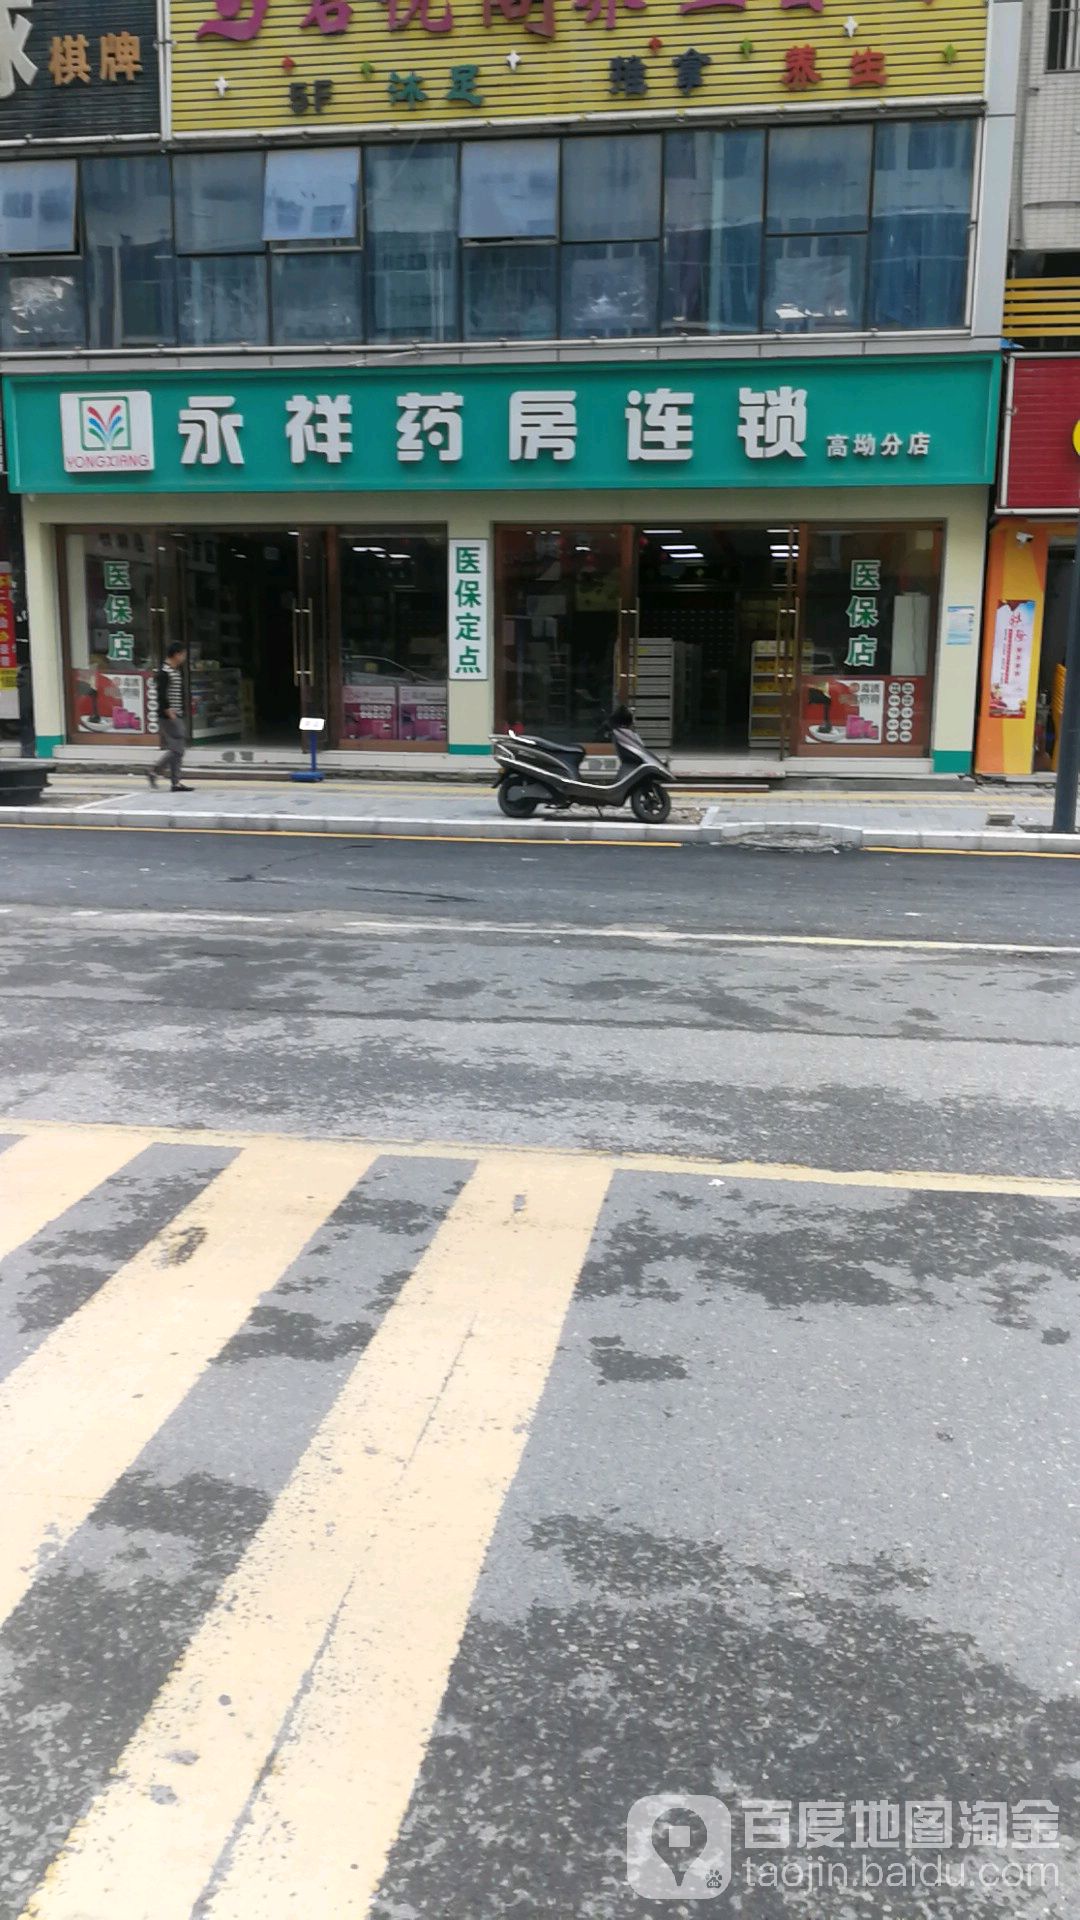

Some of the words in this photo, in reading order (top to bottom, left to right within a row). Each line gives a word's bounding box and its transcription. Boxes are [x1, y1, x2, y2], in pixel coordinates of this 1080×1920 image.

[48, 31, 142, 86] 棋牌
[387, 64, 485, 110] 沐足
[609, 47, 712, 97] 推拿
[781, 43, 889, 92] 养生
[177, 386, 808, 465] 永祥药房连锁
[826, 432, 931, 458] 高坳分店
[66, 455, 150, 470] YONGXIANG
[104, 560, 134, 662] 医保店
[454, 546, 482, 675] 医保定点
[844, 559, 882, 668] 医保店
